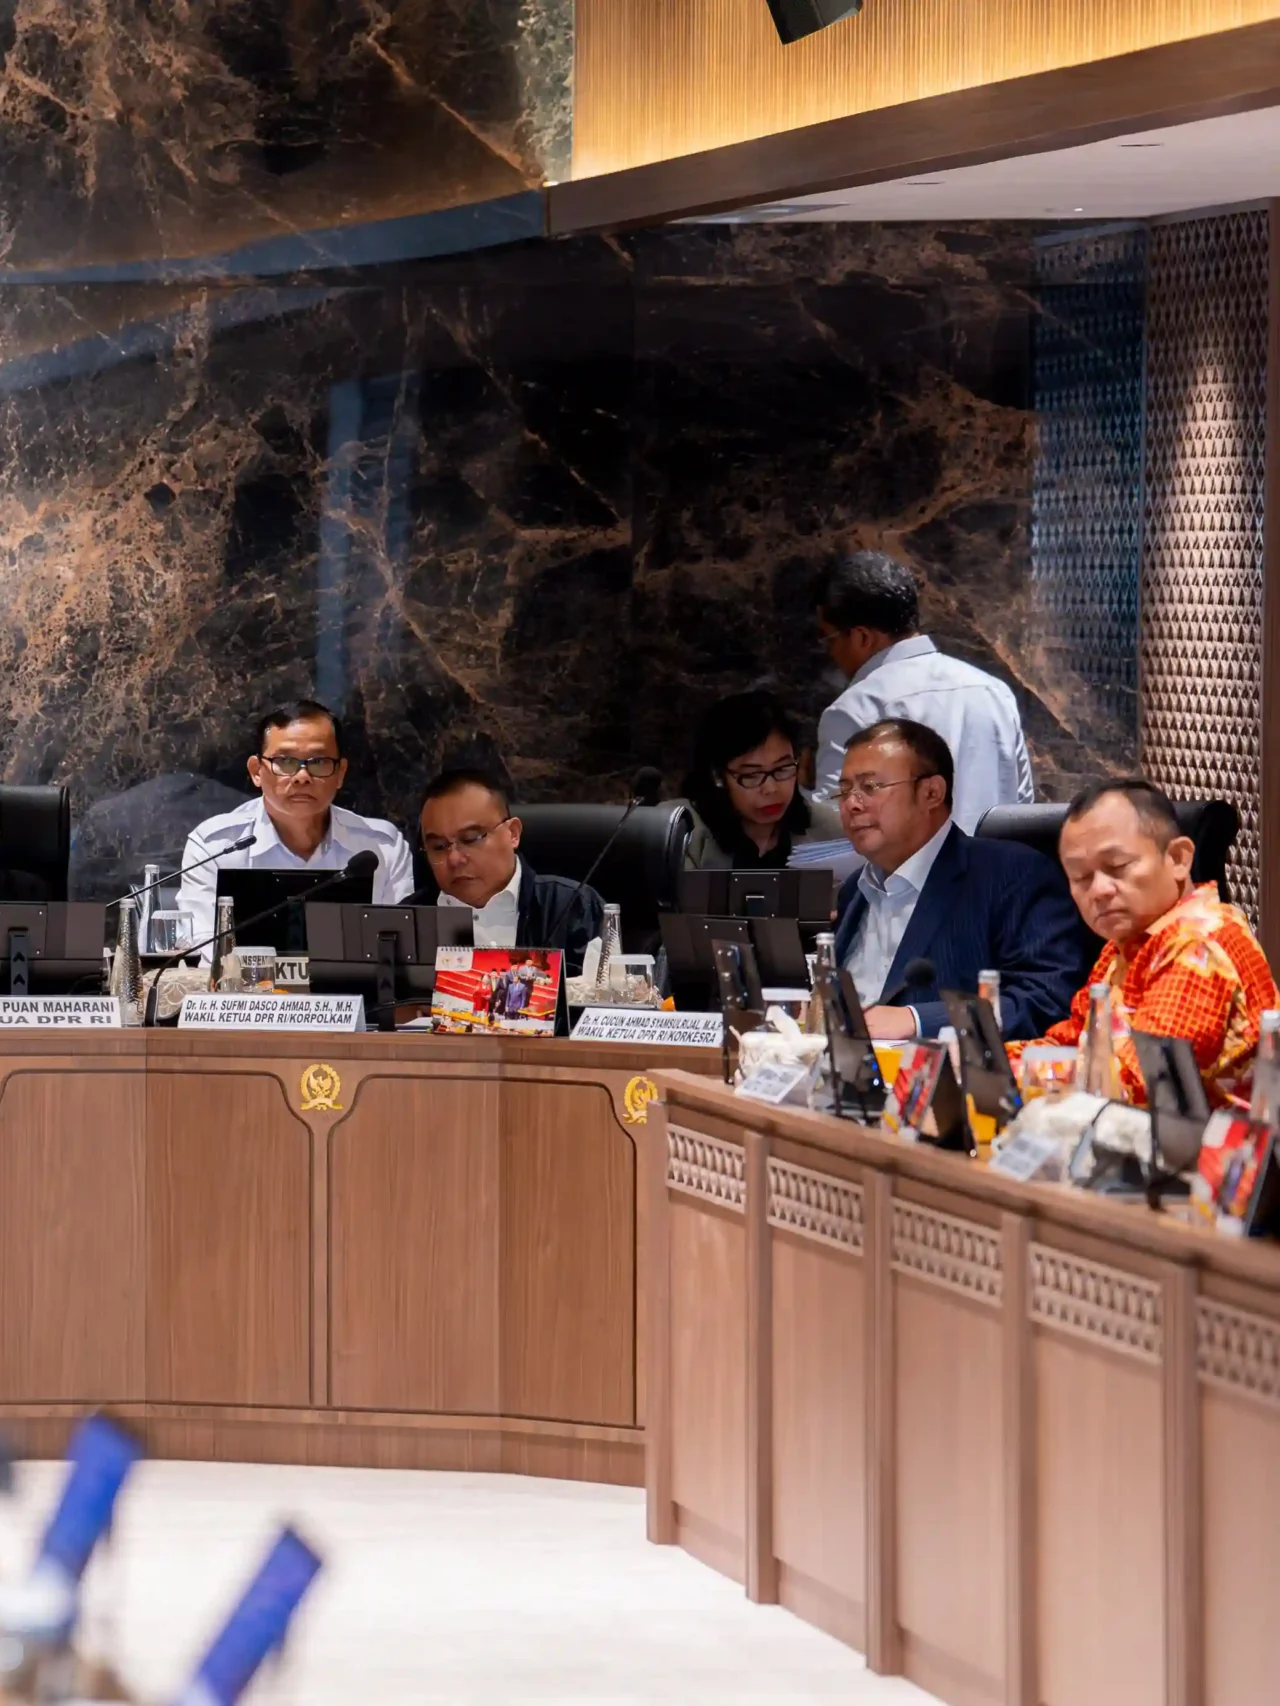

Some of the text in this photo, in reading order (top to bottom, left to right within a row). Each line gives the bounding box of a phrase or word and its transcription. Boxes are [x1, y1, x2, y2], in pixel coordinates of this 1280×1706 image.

[3, 1002, 39, 1012] PUAN
[43, 1001, 114, 1012] MAHARANI
[186, 1000, 197, 1010] Dr.
[210, 1000, 218, 1010] H.
[220, 1000, 247, 1011] SUFMI
[249, 1000, 277, 1012] DASCO
[279, 1001, 312, 1013] AHMAD,
[335, 1002, 354, 1012] M.H.
[37, 1016, 81, 1024] DPR
[90, 1016, 112, 1024] RI
[184, 1012, 216, 1022] WAKIL
[218, 1012, 251, 1023] KETUA
[254, 1012, 274, 1023] DPR
[582, 1015, 590, 1025] Dr.
[600, 1016, 625, 1027] CUCUN
[626, 1017, 650, 1028] AHMAD
[576, 1026, 605, 1037] WAKIL
[606, 1028, 637, 1039] KETUA
[637, 1029, 657, 1040] DPR
